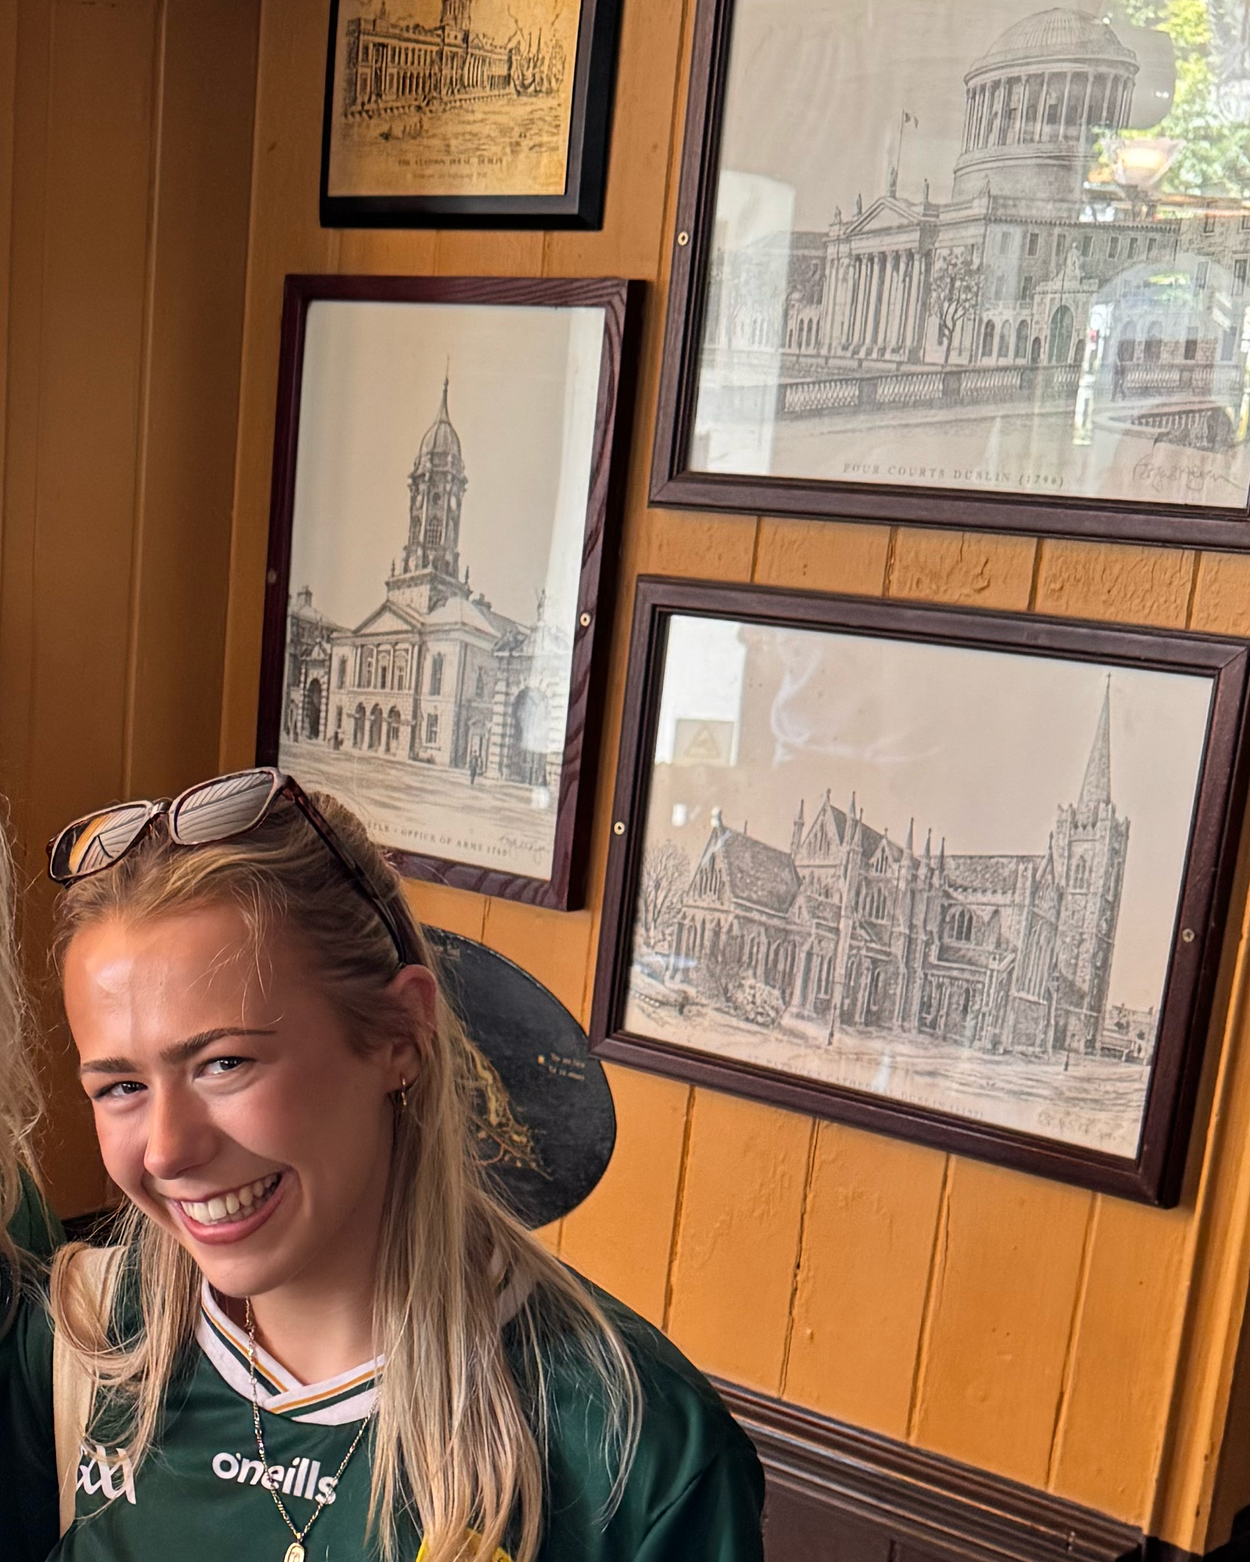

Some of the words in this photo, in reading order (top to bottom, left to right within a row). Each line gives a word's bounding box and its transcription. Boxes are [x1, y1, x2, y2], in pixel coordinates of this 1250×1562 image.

[843, 463, 879, 475] FOUR
[888, 465, 945, 480] COURTS
[953, 469, 1011, 483] DUBLIN
[76, 1445, 136, 1505] AA
